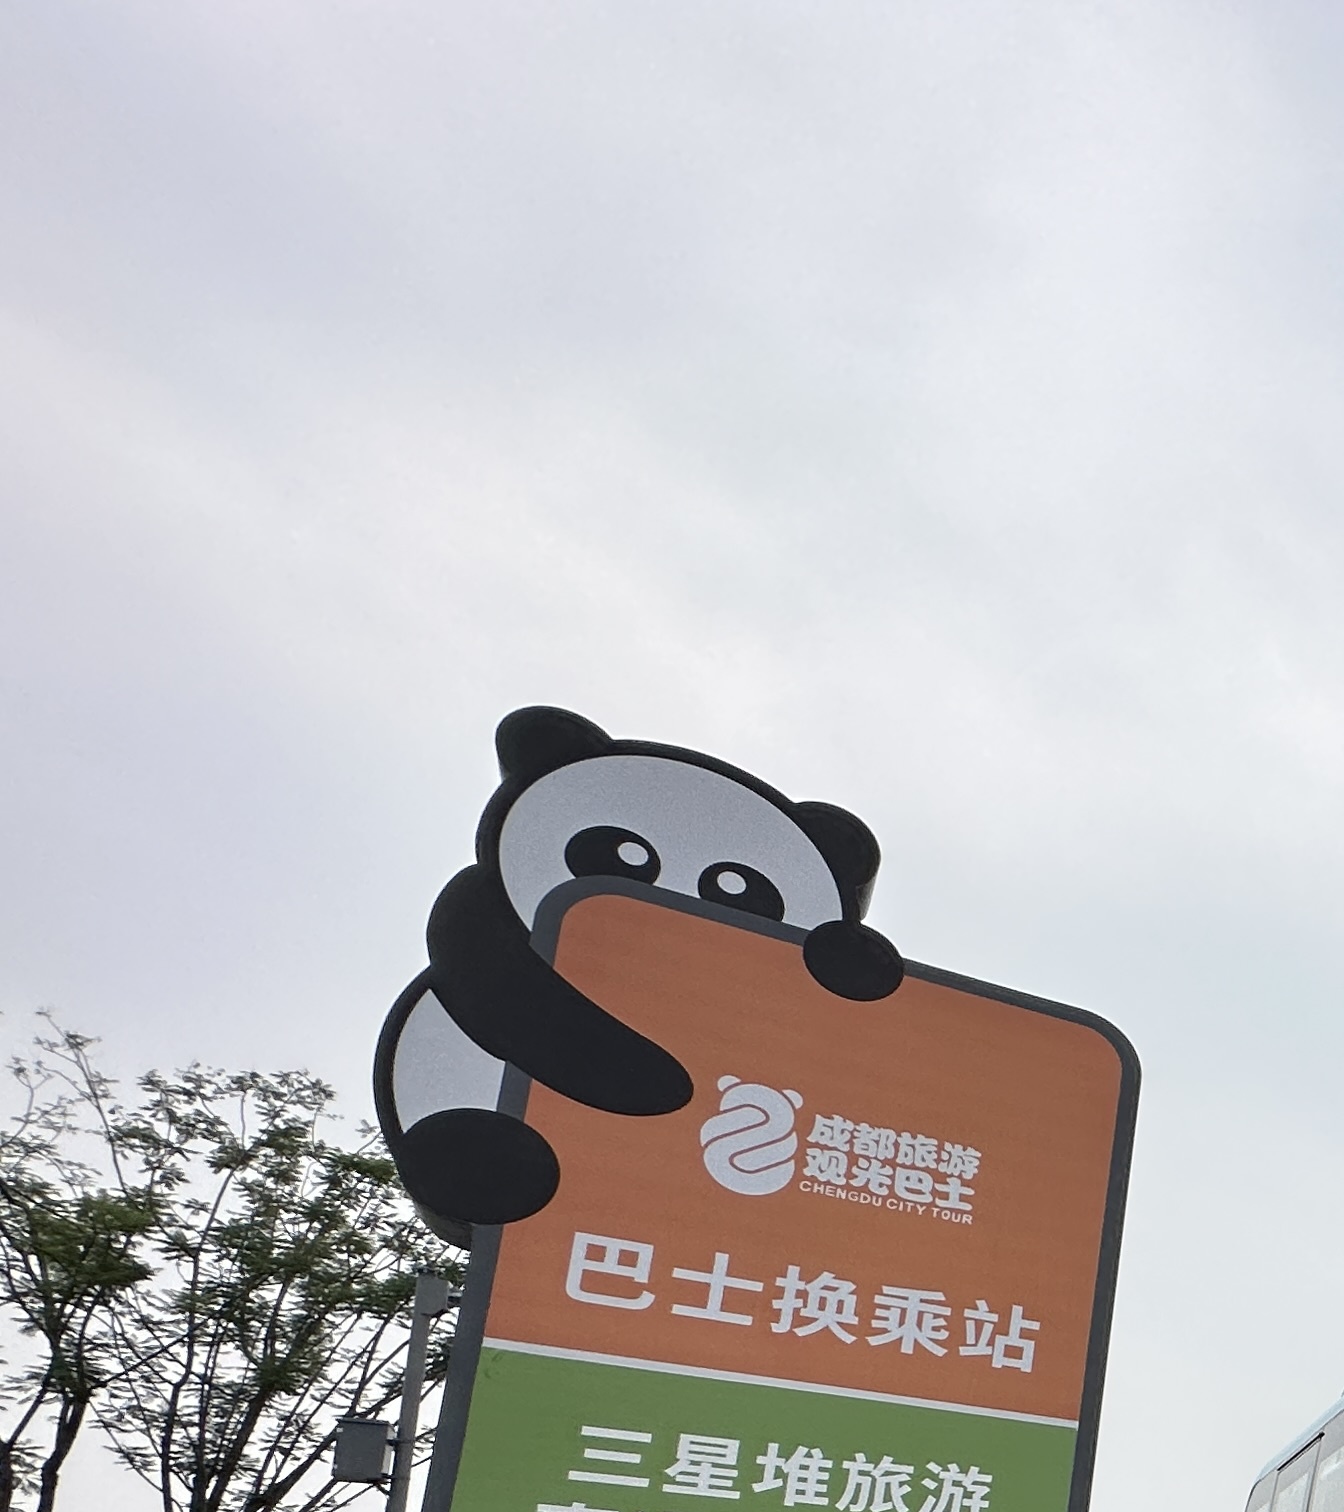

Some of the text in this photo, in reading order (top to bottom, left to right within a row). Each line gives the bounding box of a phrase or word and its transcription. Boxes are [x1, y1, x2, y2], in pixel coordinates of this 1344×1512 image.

[806, 1114, 982, 1179] 成都旅游
[799, 1180, 973, 1225] CHENGDU CITY TOUR
[803, 1148, 975, 1211] 观光巴士
[565, 1231, 1041, 1374] 巴士换乘站
